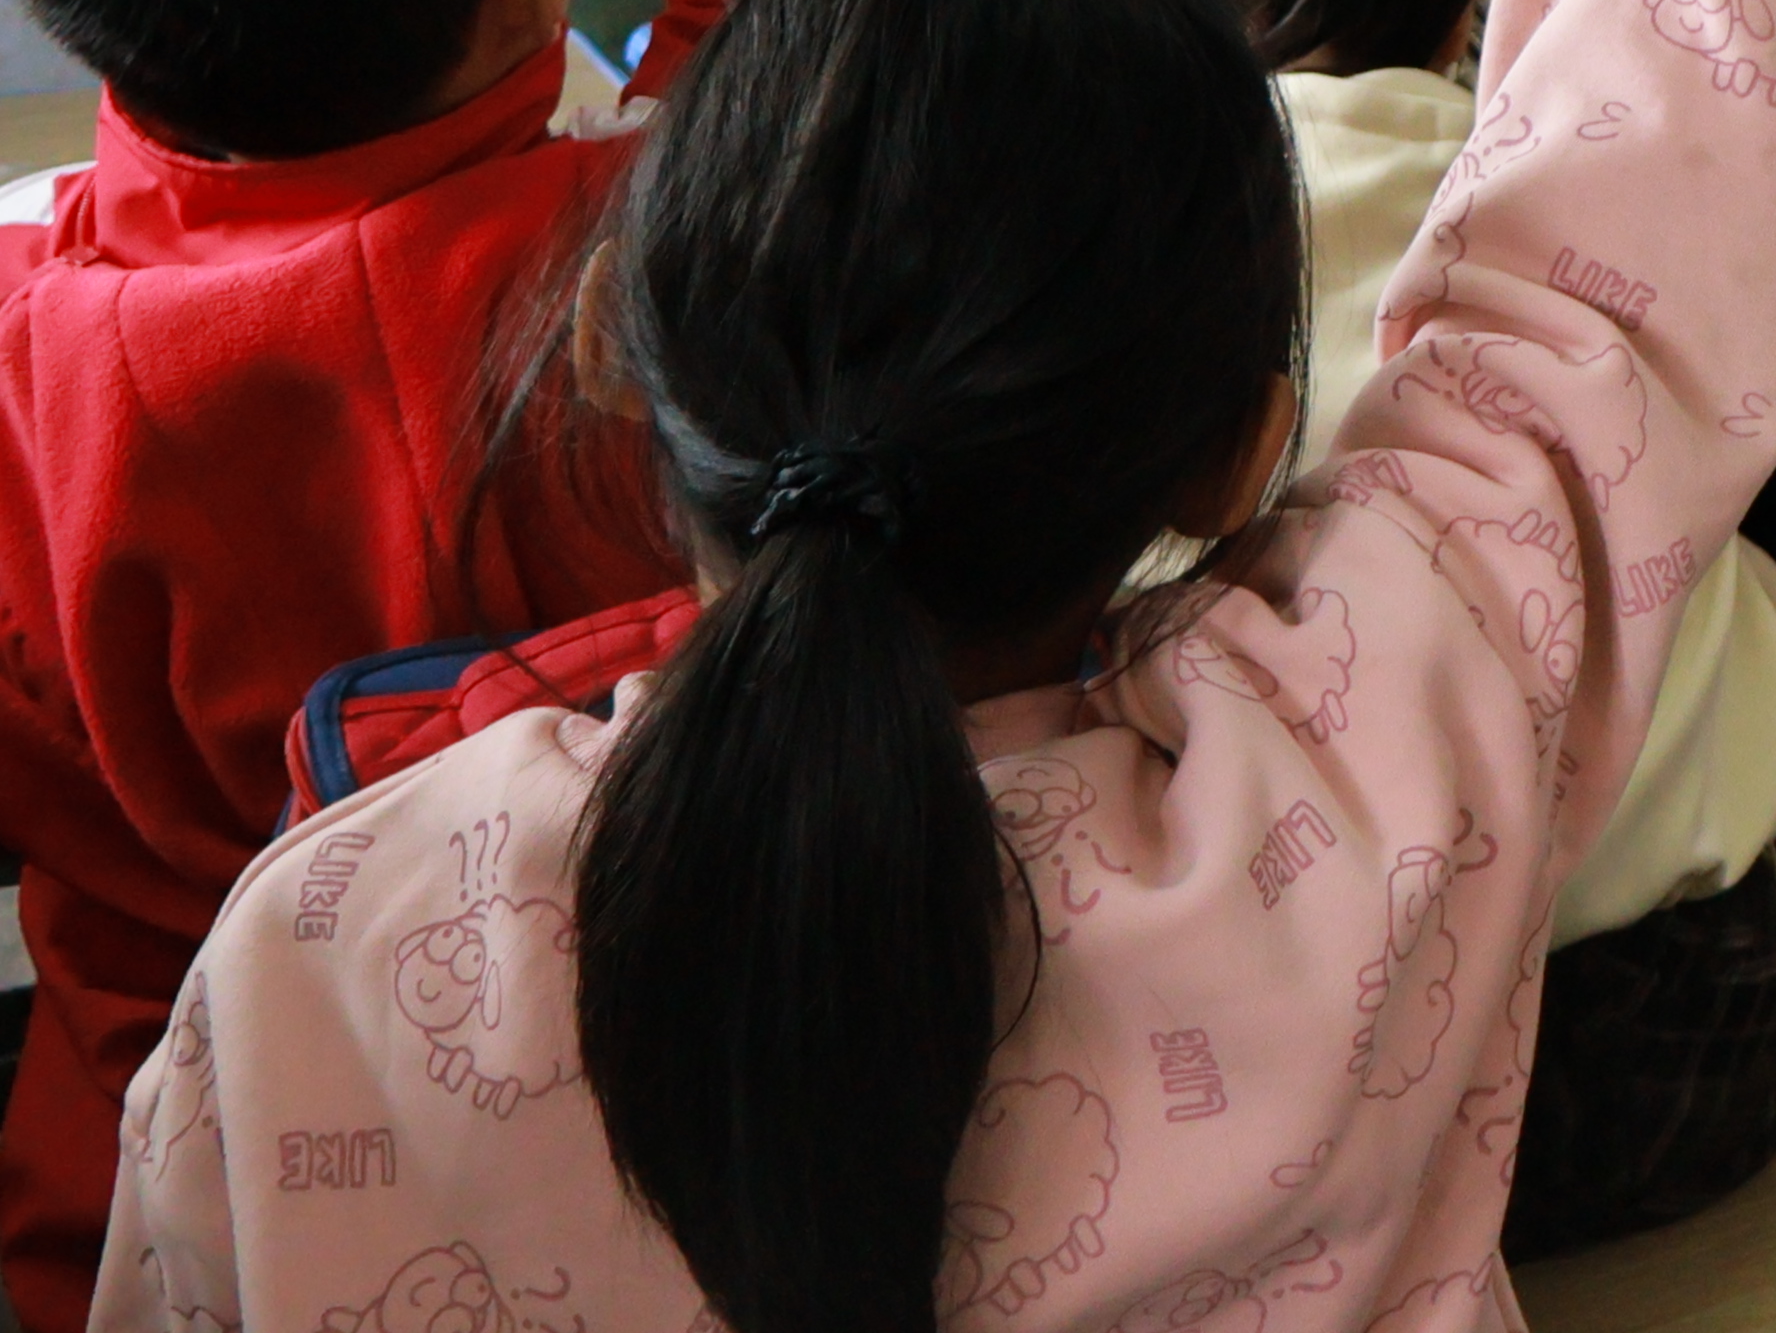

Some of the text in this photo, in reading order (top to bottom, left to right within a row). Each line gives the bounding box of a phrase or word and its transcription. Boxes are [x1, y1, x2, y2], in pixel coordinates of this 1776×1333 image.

[1548, 246, 1657, 331] LIKE
[1614, 537, 1697, 617] LIKE
[295, 832, 375, 942] LIKE
[1248, 798, 1337, 910] LIKE
[1150, 1027, 1228, 1123] LIKE
[278, 1127, 396, 1191] LIKE
